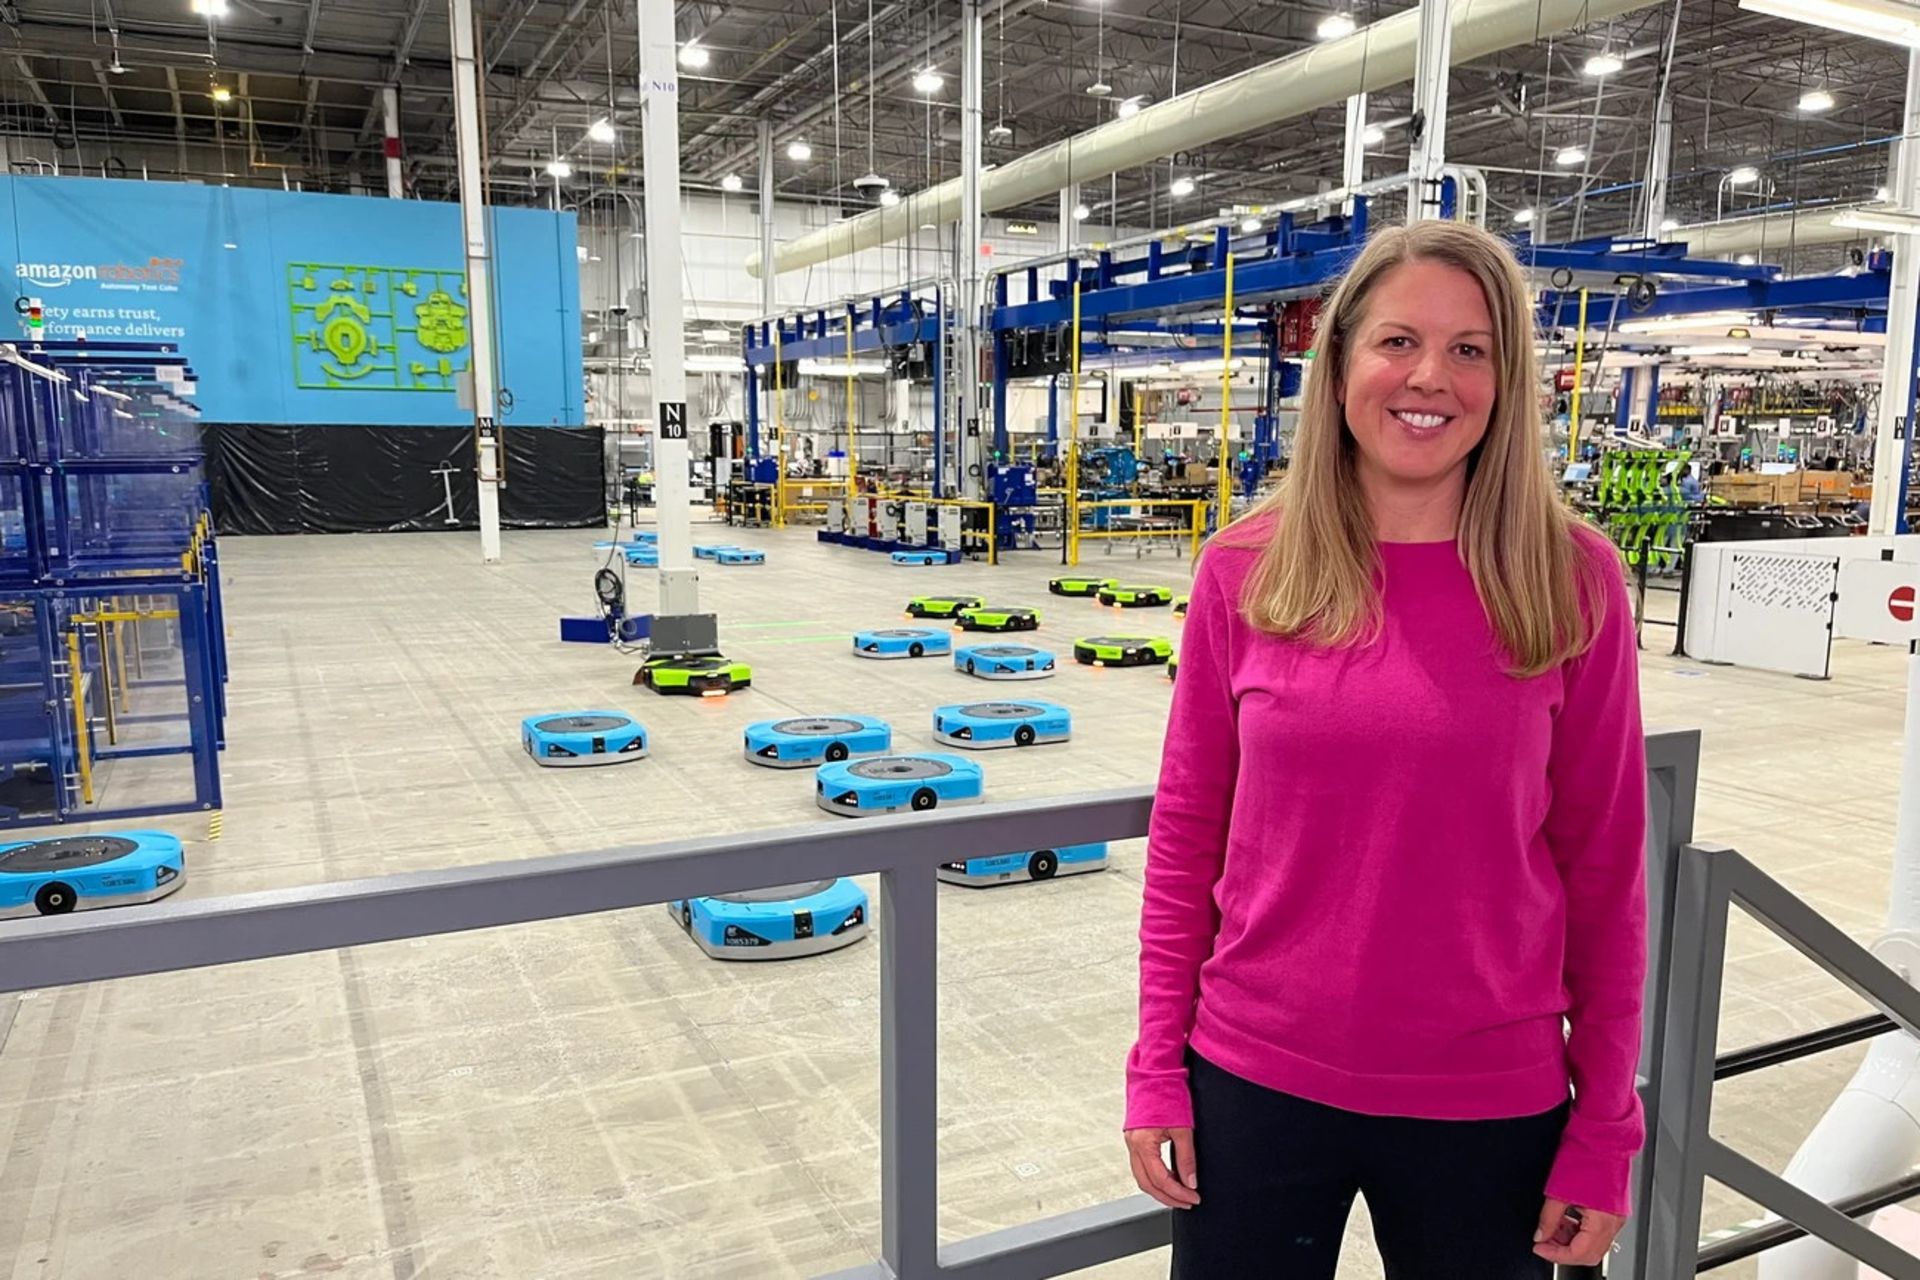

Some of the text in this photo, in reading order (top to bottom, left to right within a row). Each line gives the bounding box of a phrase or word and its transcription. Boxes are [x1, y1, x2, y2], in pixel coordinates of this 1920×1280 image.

[652, 80, 675, 91] N10
[16, 263, 96, 279] amazon
[142, 283, 158, 291] Test
[73, 307, 115, 318] earns
[118, 307, 161, 321] trust,
[129, 325, 185, 337] delivers
[666, 404, 680, 421] N
[480, 418, 491, 428] M
[666, 424, 681, 437] 10
